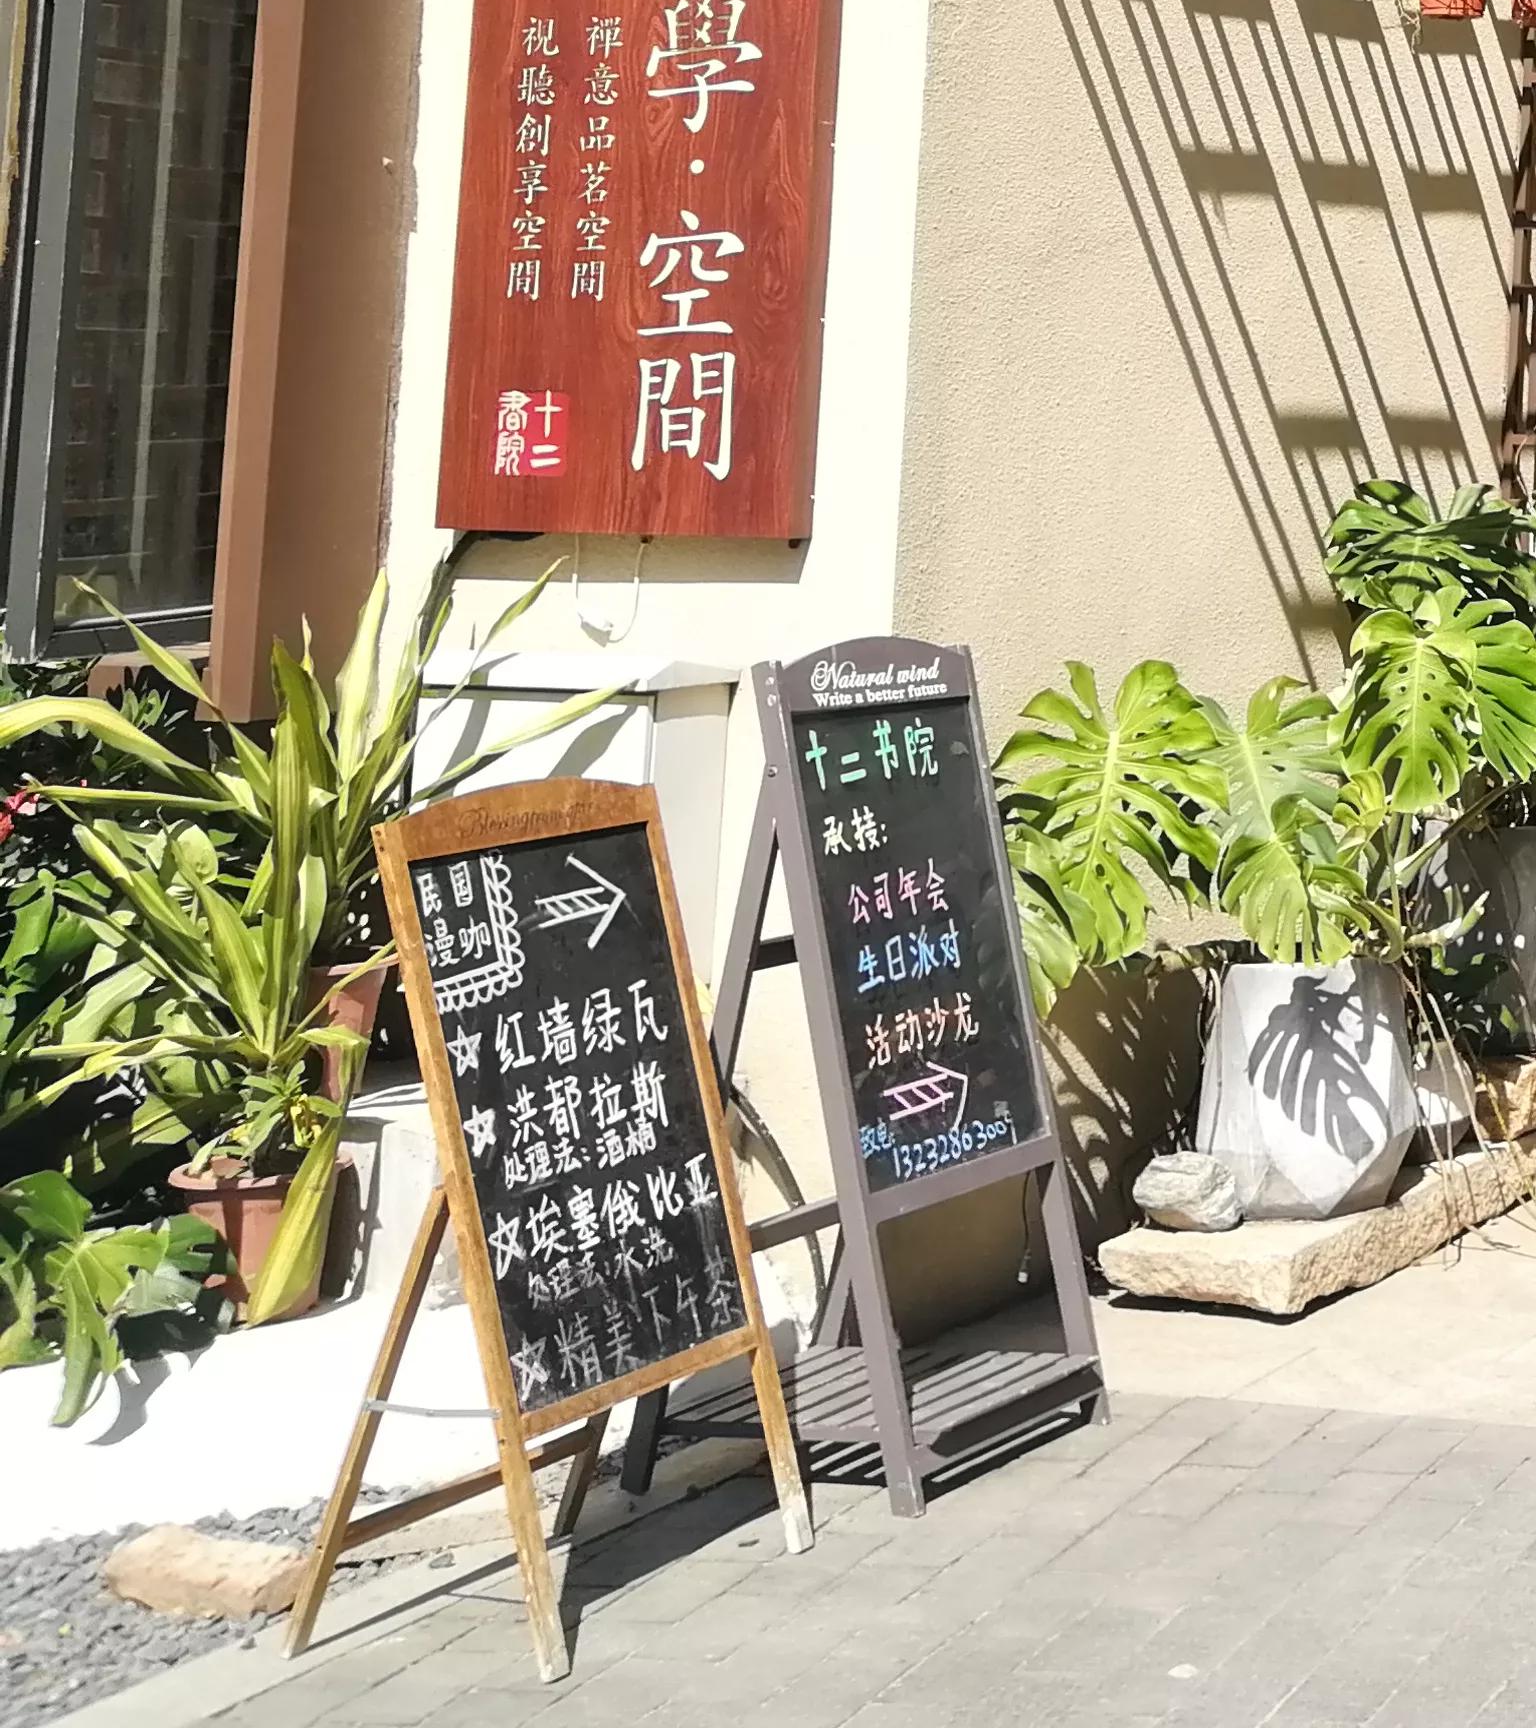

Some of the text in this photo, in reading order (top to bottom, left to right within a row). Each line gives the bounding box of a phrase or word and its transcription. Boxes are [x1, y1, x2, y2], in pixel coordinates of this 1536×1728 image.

[507, 17, 559, 301] 視聽創享空間
[571, 17, 623, 302] 禪意品茗空間
[811, 657, 941, 691] Natural wind
[812, 682, 948, 708] Write a better future
[805, 717, 939, 791] 十二书院
[416, 860, 474, 918] 民国
[848, 858, 949, 925] 公司年会
[424, 915, 492, 968] 漫咖
[857, 918, 962, 994] 生日派对
[495, 978, 669, 1074] 红墙绿瓦
[865, 991, 980, 1070] 活动沙龙
[507, 1059, 669, 1149] 洪都拉斯
[525, 1153, 718, 1263] 埃塞俄比亚
[553, 1245, 743, 1388] 精美下午茶
